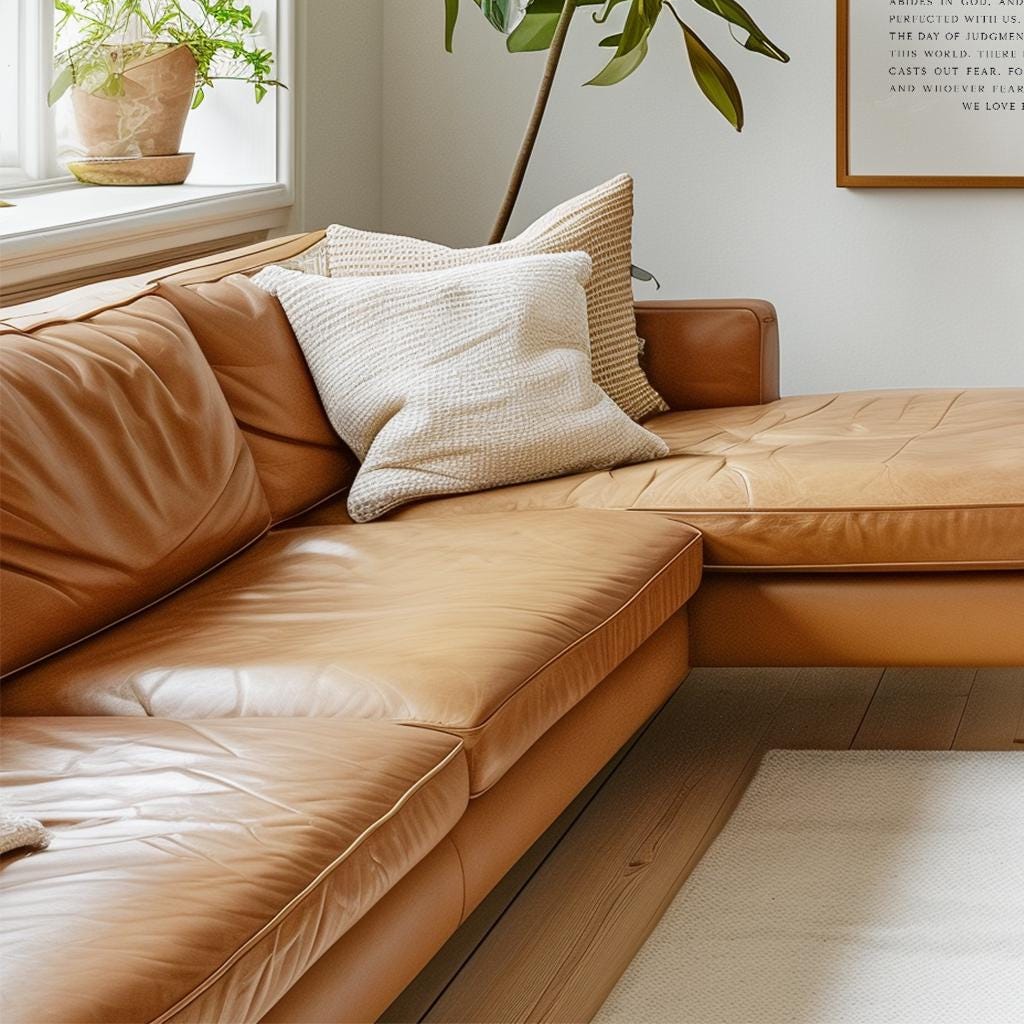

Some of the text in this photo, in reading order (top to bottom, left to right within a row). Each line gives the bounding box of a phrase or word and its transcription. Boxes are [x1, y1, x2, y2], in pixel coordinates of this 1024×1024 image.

[889, 15, 959, 24] PERFECTED
[963, 15, 997, 24] WITH
[888, 31, 913, 41] THE
[917, 31, 940, 41] DAY
[944, 31, 961, 41] OF
[891, 49, 918, 58] THIS
[979, 49, 1017, 59] THERE
[888, 66, 927, 76] CASTS
[933, 66, 959, 76] OUT
[889, 84, 916, 93] AND
[922, 84, 985, 93] WHOEVER
[961, 101, 980, 111] WE
[985, 101, 1016, 111] LOVE
